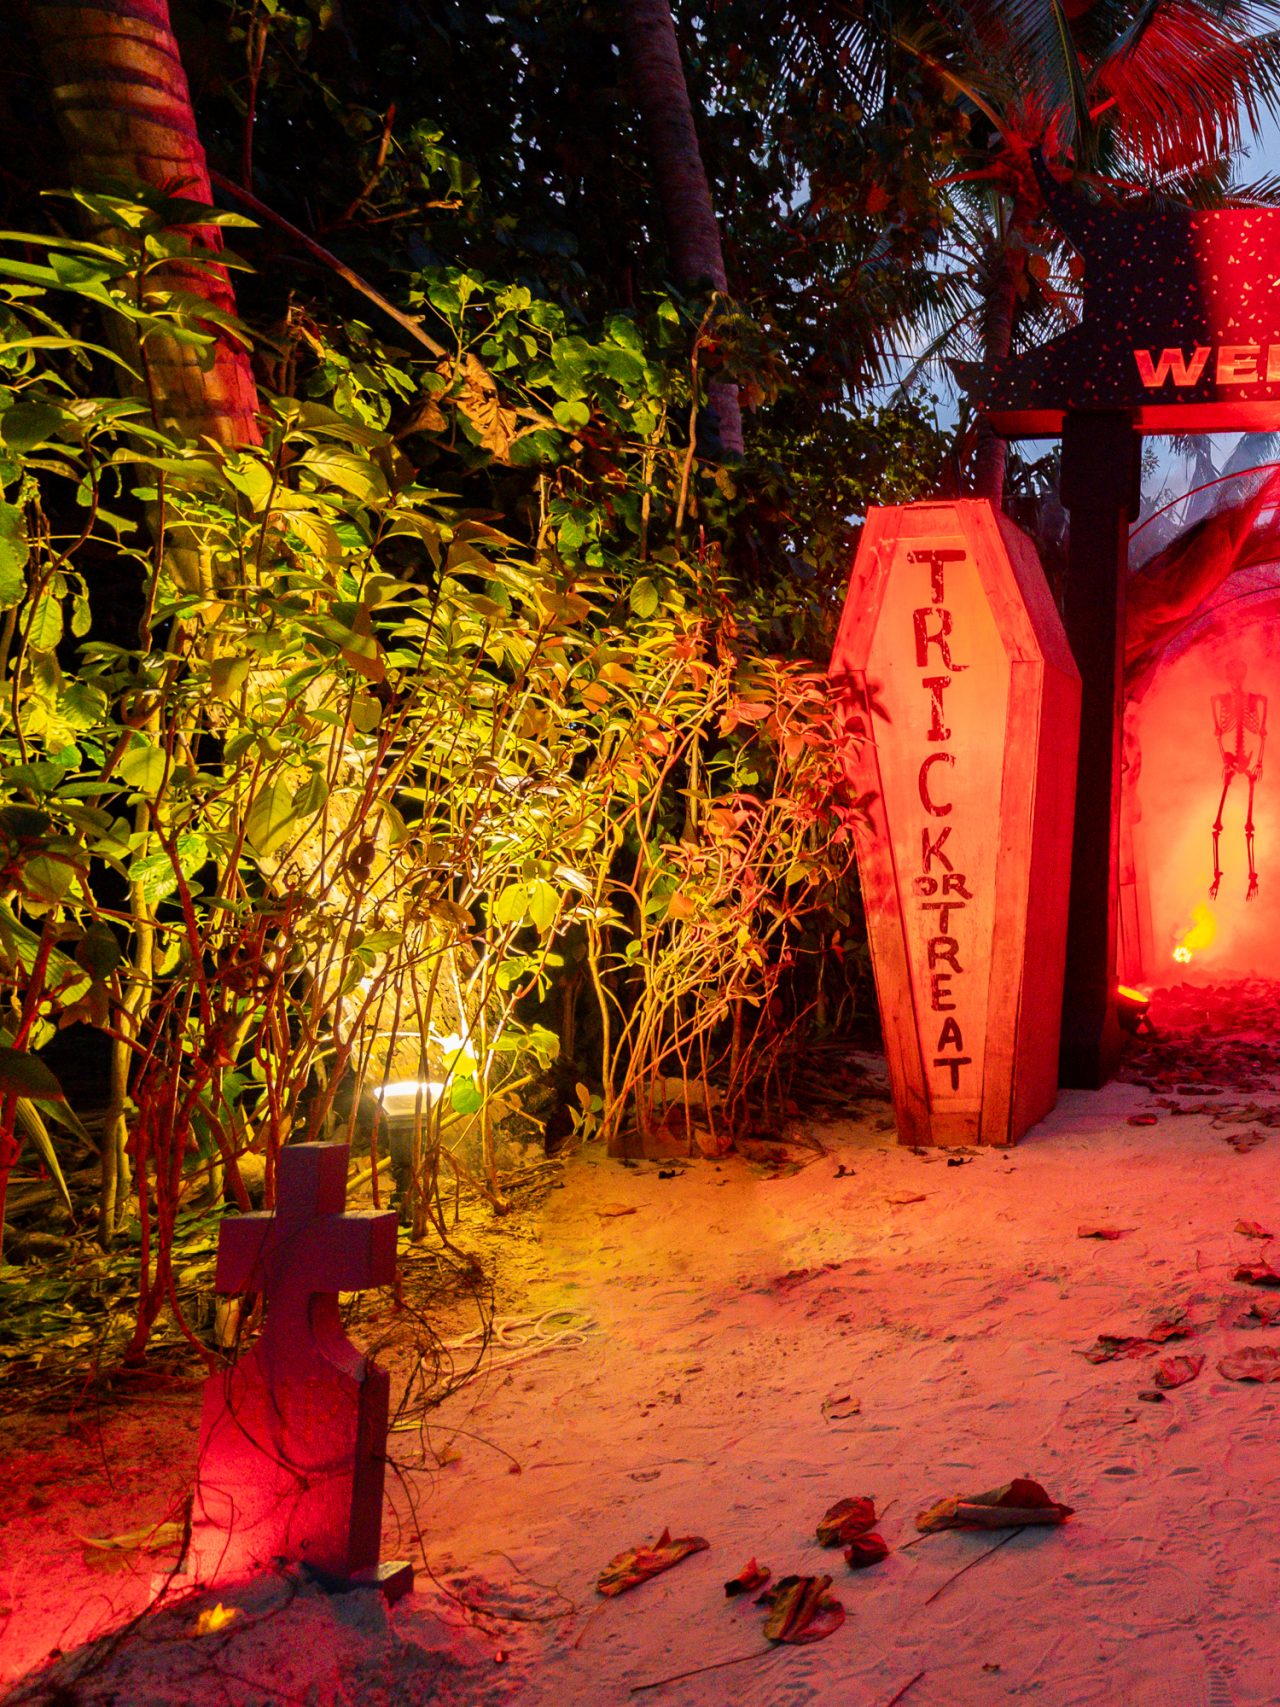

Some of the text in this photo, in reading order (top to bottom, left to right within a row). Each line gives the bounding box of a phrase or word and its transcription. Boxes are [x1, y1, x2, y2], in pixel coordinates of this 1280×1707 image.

[906, 549, 974, 1092] TRICK OR TREAT
